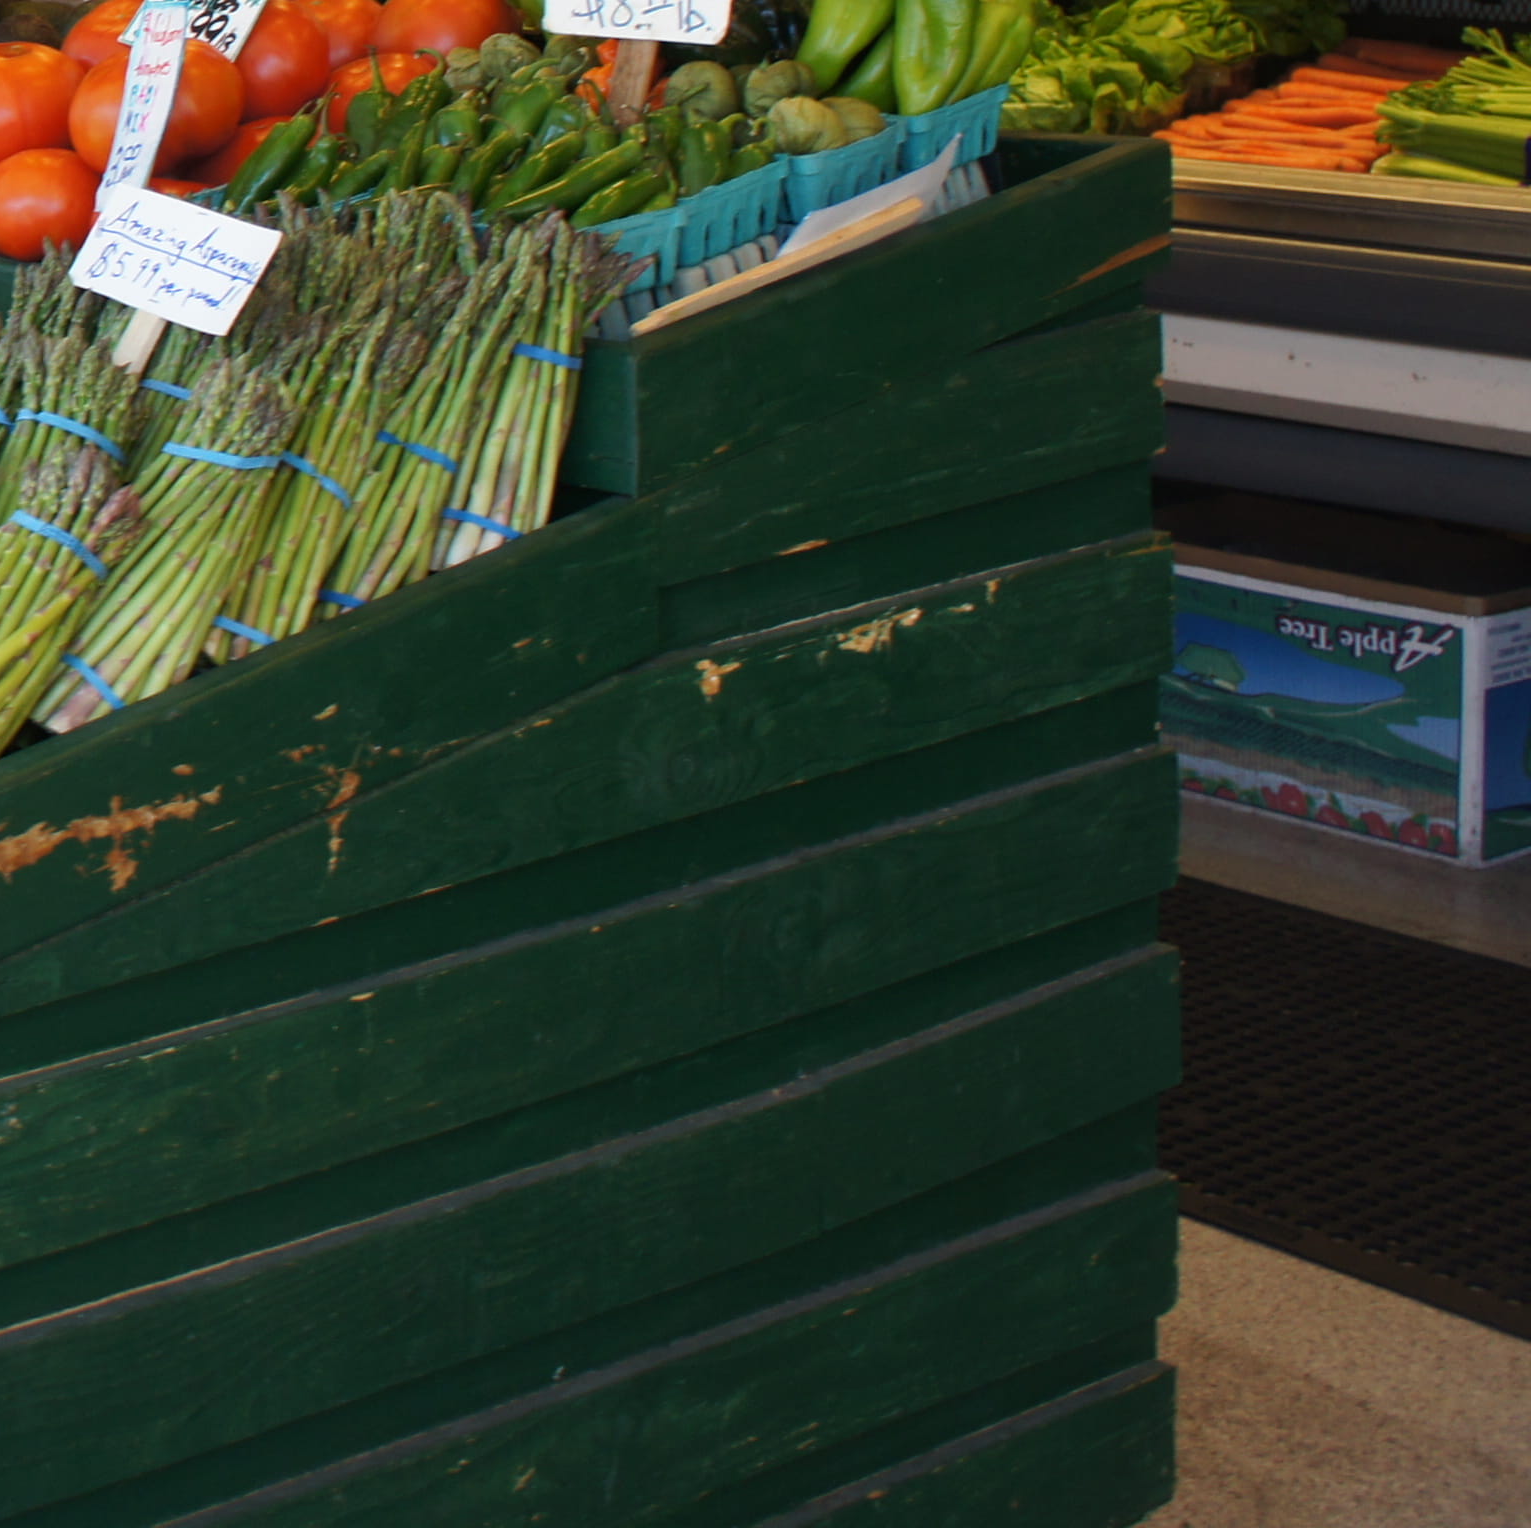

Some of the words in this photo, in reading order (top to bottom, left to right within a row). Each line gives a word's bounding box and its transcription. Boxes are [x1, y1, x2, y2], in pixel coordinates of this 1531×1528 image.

[107, 200, 188, 266] Amazing
[1279, 616, 1336, 652] Tree
[1340, 623, 1456, 673] Apple
